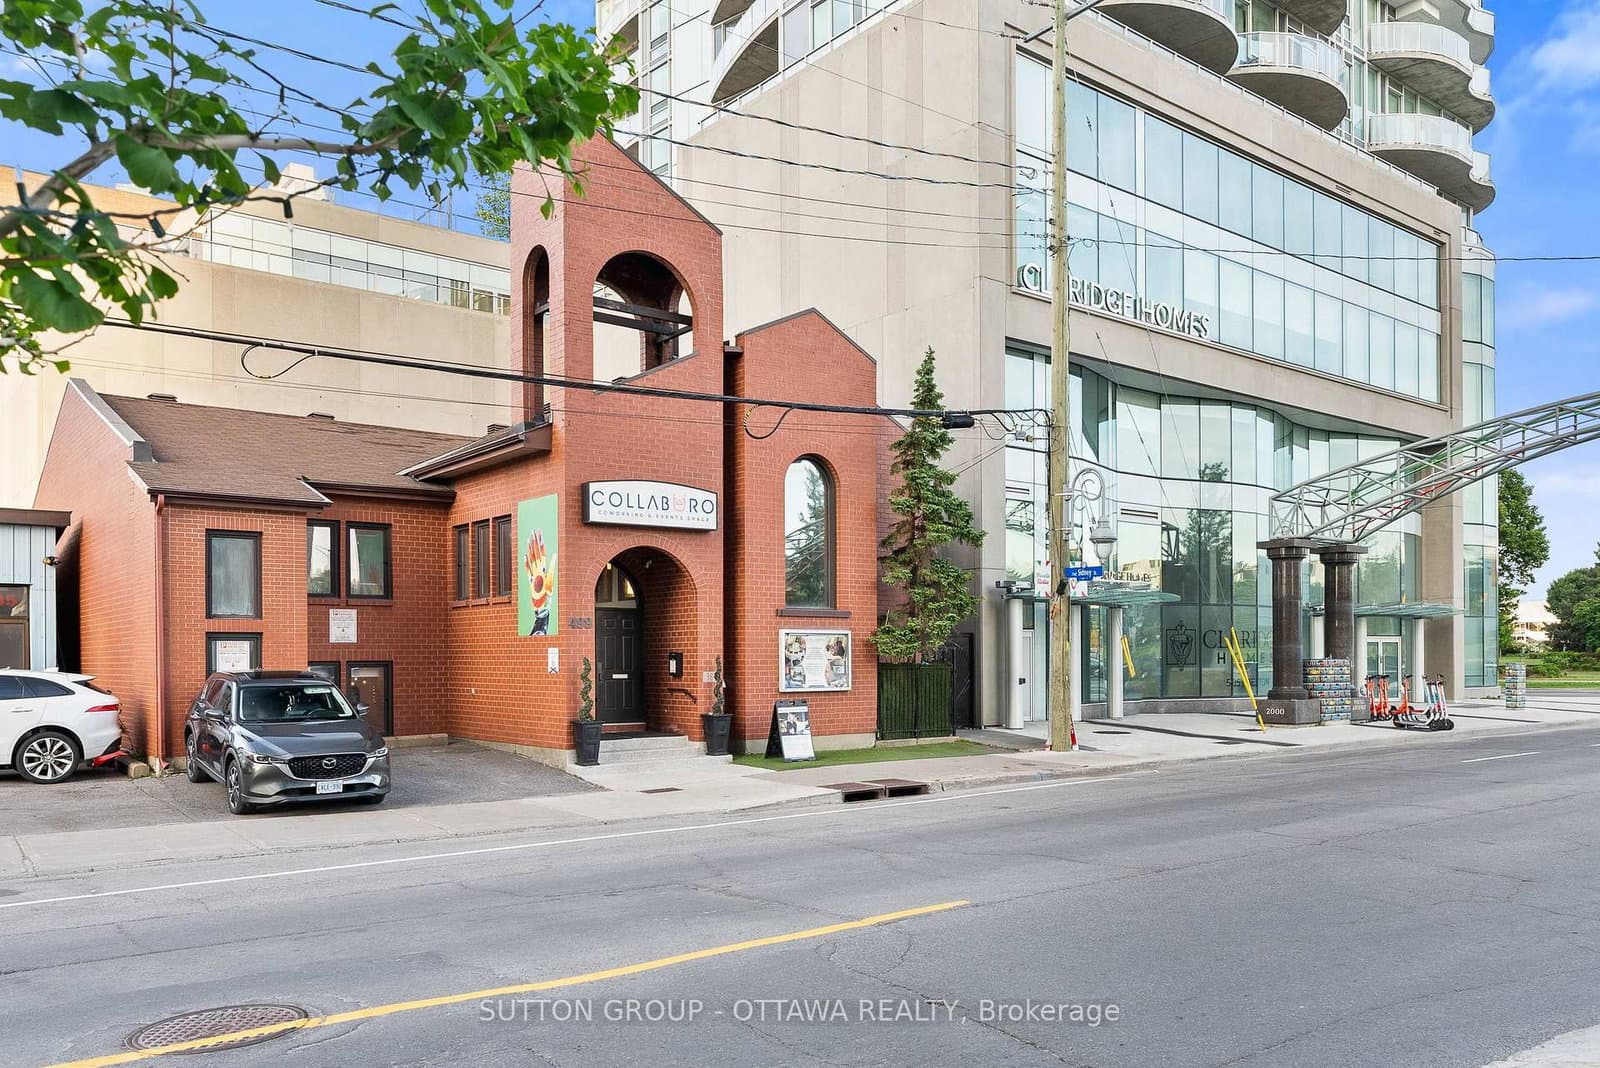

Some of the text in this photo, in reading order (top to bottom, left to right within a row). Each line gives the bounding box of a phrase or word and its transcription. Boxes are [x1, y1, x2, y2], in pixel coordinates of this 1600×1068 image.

[1020, 262, 1210, 338] CLRIDGE HOMES
[1266, 707, 1285, 715] 2000
